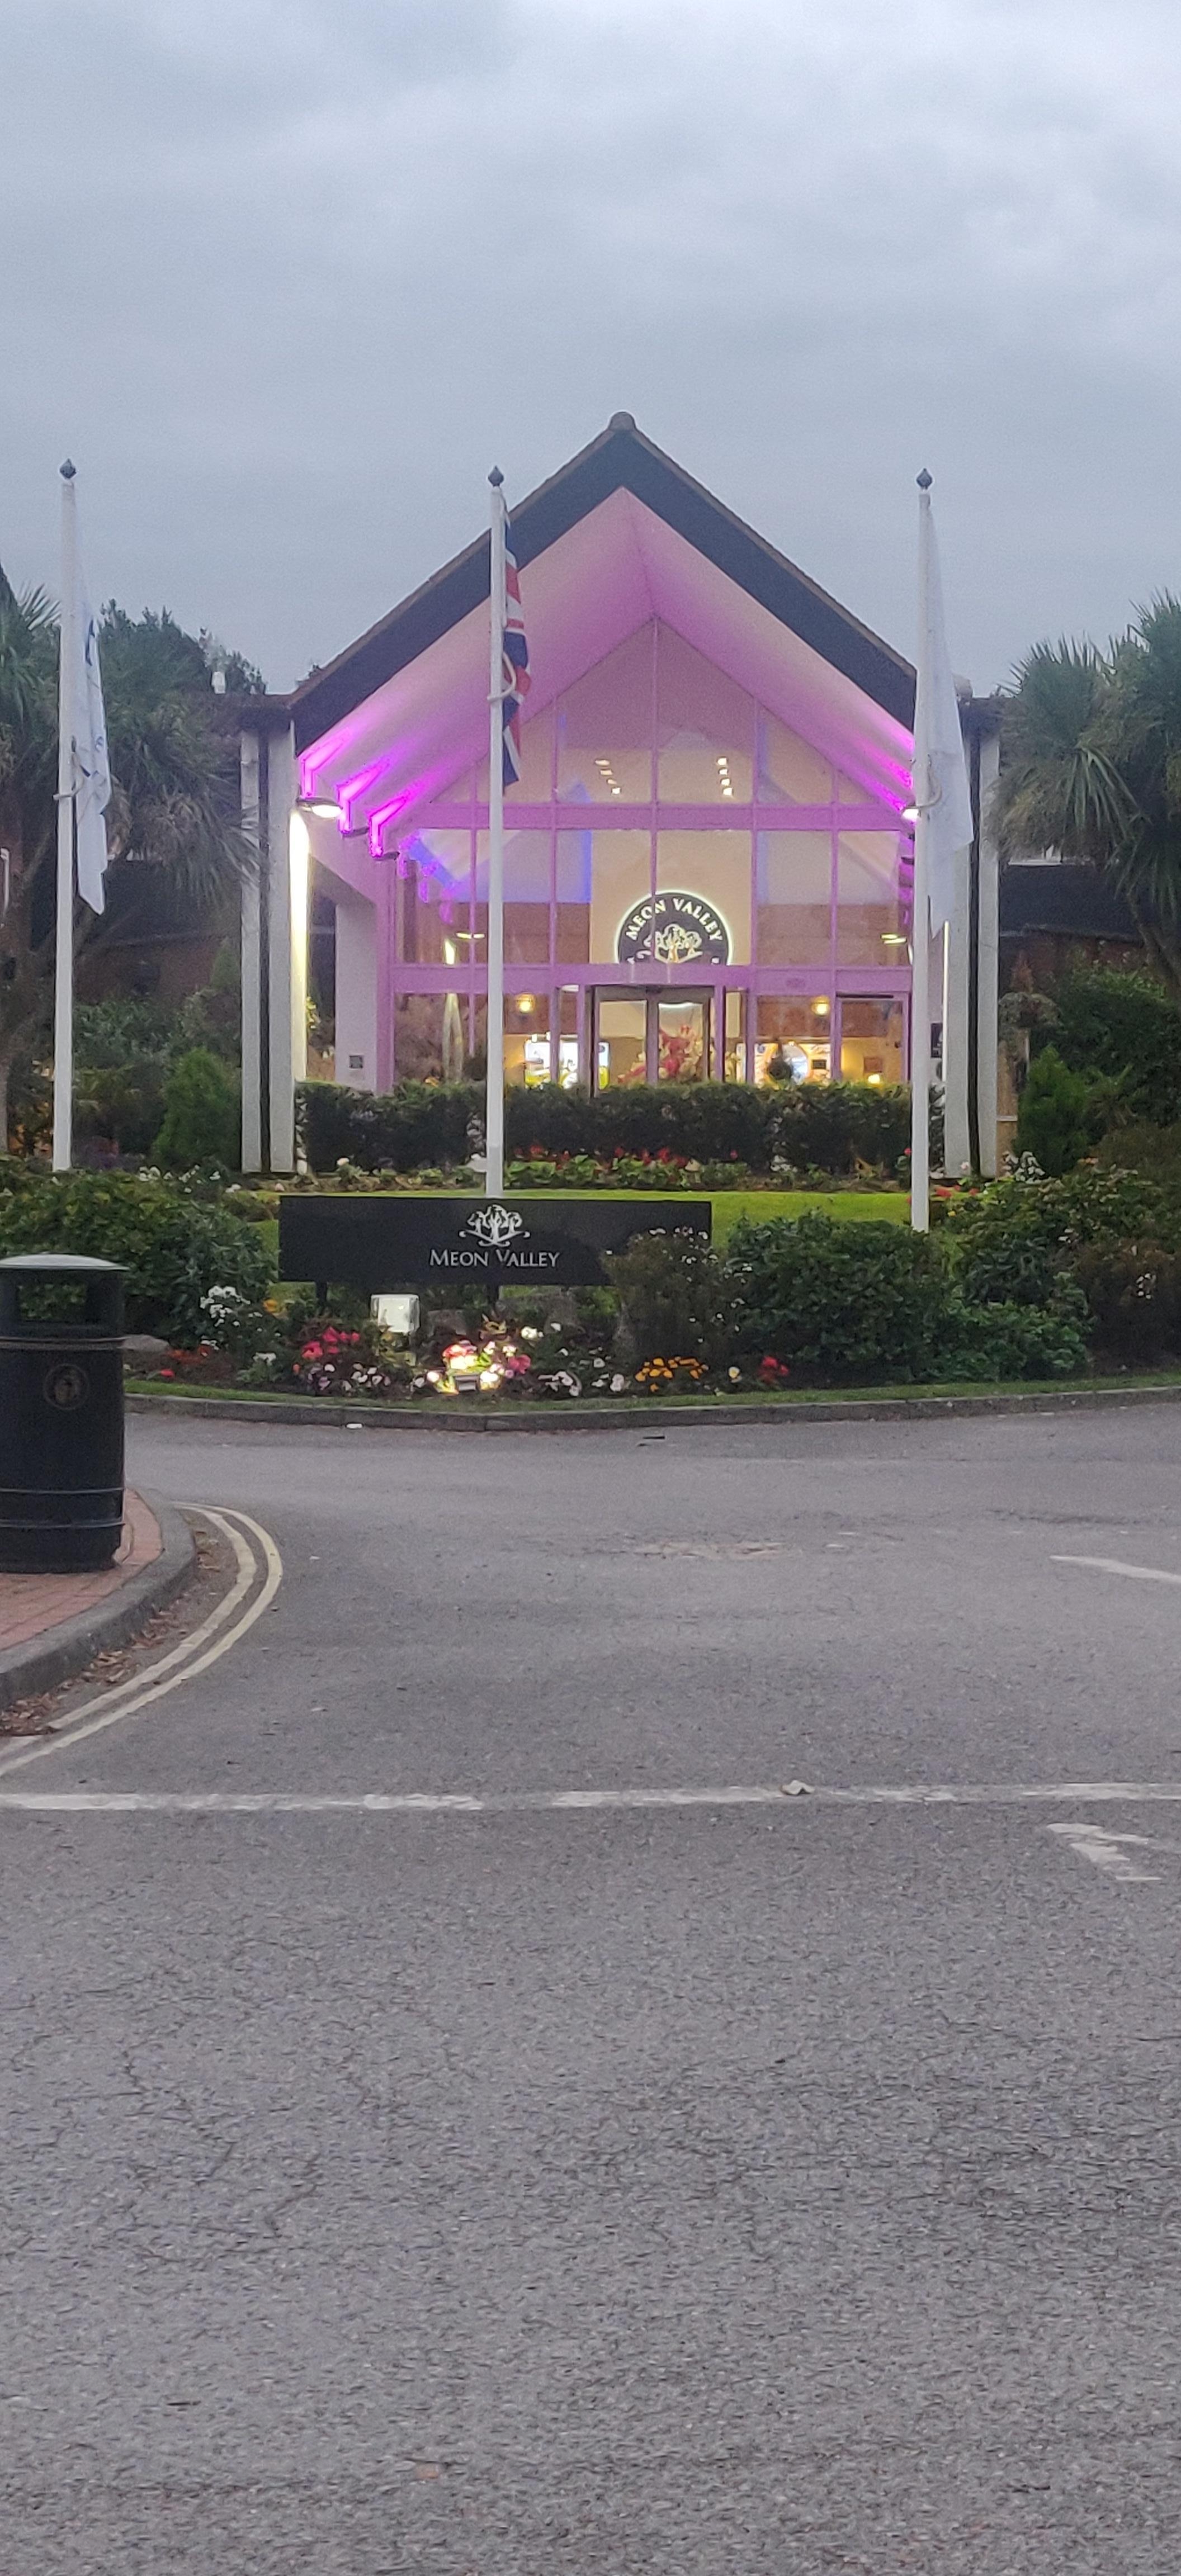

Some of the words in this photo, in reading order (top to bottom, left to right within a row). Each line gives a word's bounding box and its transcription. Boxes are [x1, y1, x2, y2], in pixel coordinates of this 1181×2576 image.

[626, 899, 667, 940] MEON
[673, 898, 722, 941] VALLEY
[429, 1249, 488, 1267] MEON
[496, 1249, 560, 1267] VALLEY
